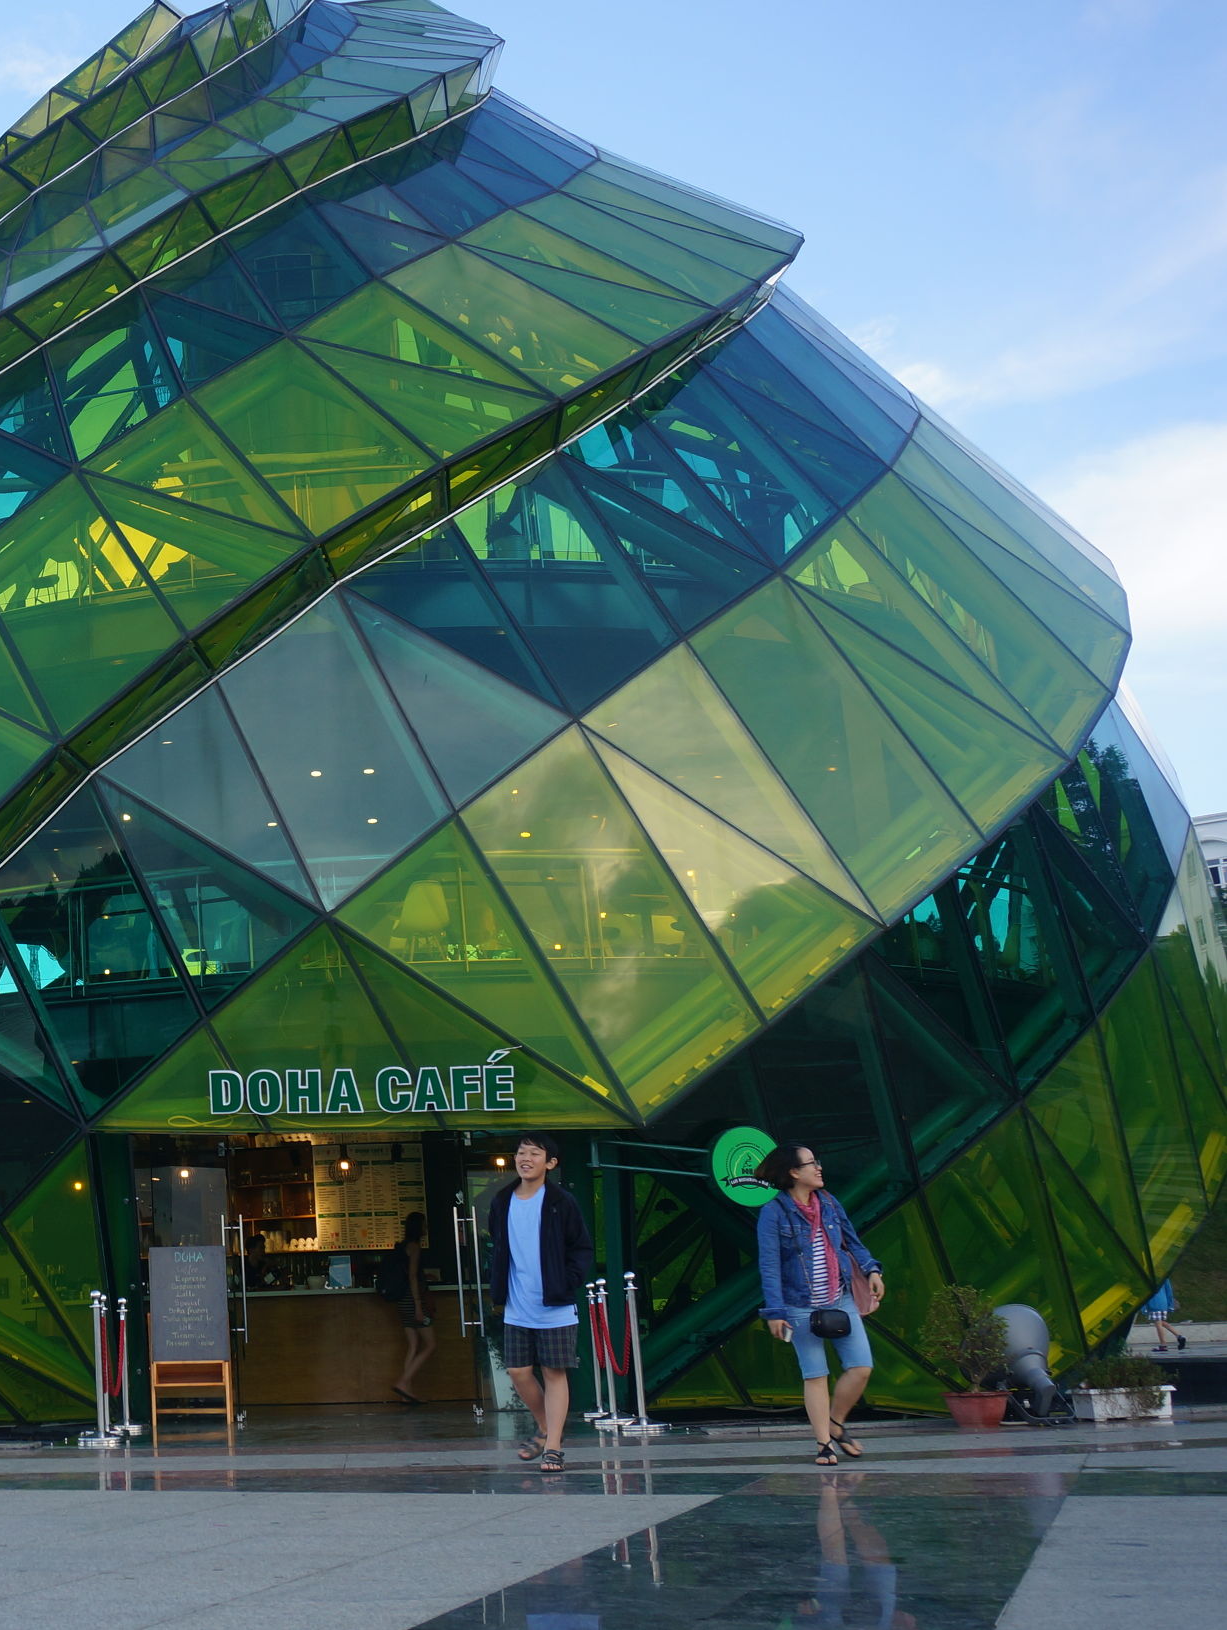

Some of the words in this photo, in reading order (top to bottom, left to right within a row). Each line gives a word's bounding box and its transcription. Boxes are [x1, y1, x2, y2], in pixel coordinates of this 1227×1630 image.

[208, 1068, 364, 1116] DOHA
[375, 1050, 516, 1113] CAFÉ
[174, 1251, 204, 1263] DOHA
